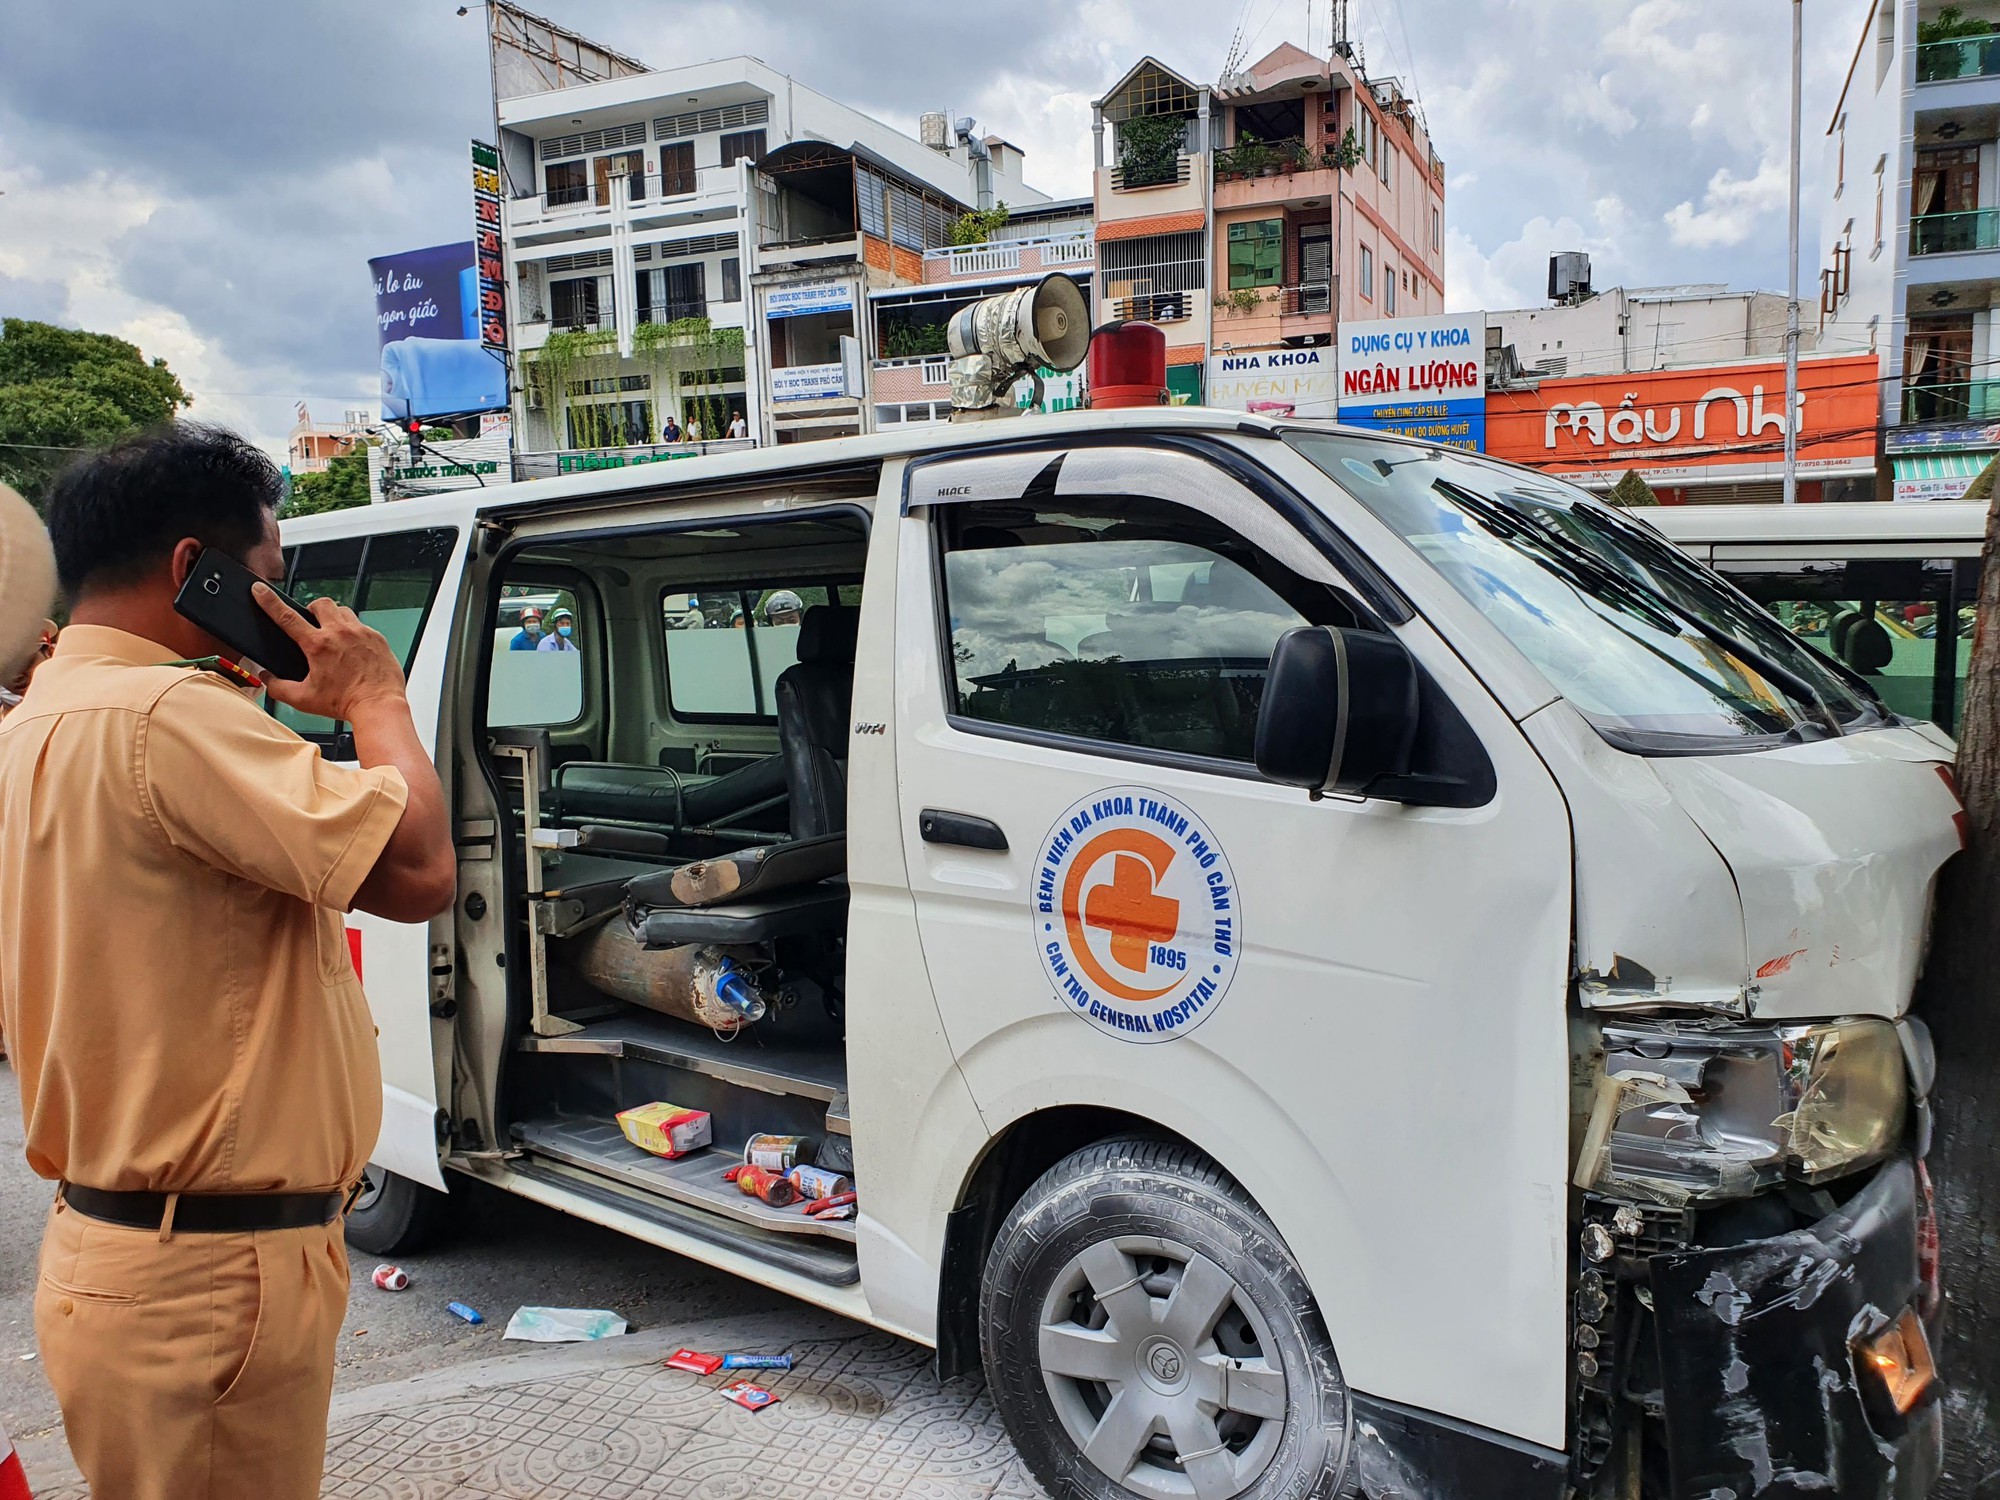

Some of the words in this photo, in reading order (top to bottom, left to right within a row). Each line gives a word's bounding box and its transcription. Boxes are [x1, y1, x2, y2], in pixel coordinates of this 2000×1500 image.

[479, 200, 503, 281] NAM
[387, 270, 400, 293] lo
[403, 273, 423, 291] âu
[377, 310, 406, 331] ngon
[409, 298, 438, 327] giấc
[1352, 334, 1390, 356] DỤNG
[1395, 332, 1413, 353] CỤ
[1418, 331, 1427, 348] Y
[1431, 328, 1470, 347] KHOA
[1222, 357, 1260, 371] NHA
[1268, 352, 1320, 367] KHOA
[1344, 362, 1400, 395] NGÂN
[1409, 360, 1477, 394] LƯỢNG
[1397, 407, 1413, 417] CUNG
[1414, 403, 1425, 417] CẤP
[1434, 406, 1438, 416] &
[1429, 422, 1449, 437] ĐƯỜNG
[1451, 420, 1470, 435] HUYẾT
[938, 486, 971, 497] HIACE
[1070, 810, 1092, 835] ĐA
[1092, 797, 1133, 821] KHOA
[1139, 798, 1189, 837] THÀNH
[1046, 828, 1073, 866] VIỆN
[1185, 830, 1220, 869] PHỐ
[1037, 866, 1056, 913] BỆNH
[1206, 871, 1232, 911] CẦN
[1214, 917, 1232, 957] THƠ
[1149, 945, 1186, 971] 1895
[1046, 941, 1068, 977] CAN
[1062, 973, 1090, 1008] THO
[1089, 1000, 1152, 1033] GENERAL
[1153, 975, 1217, 1031] HOSPITAL
